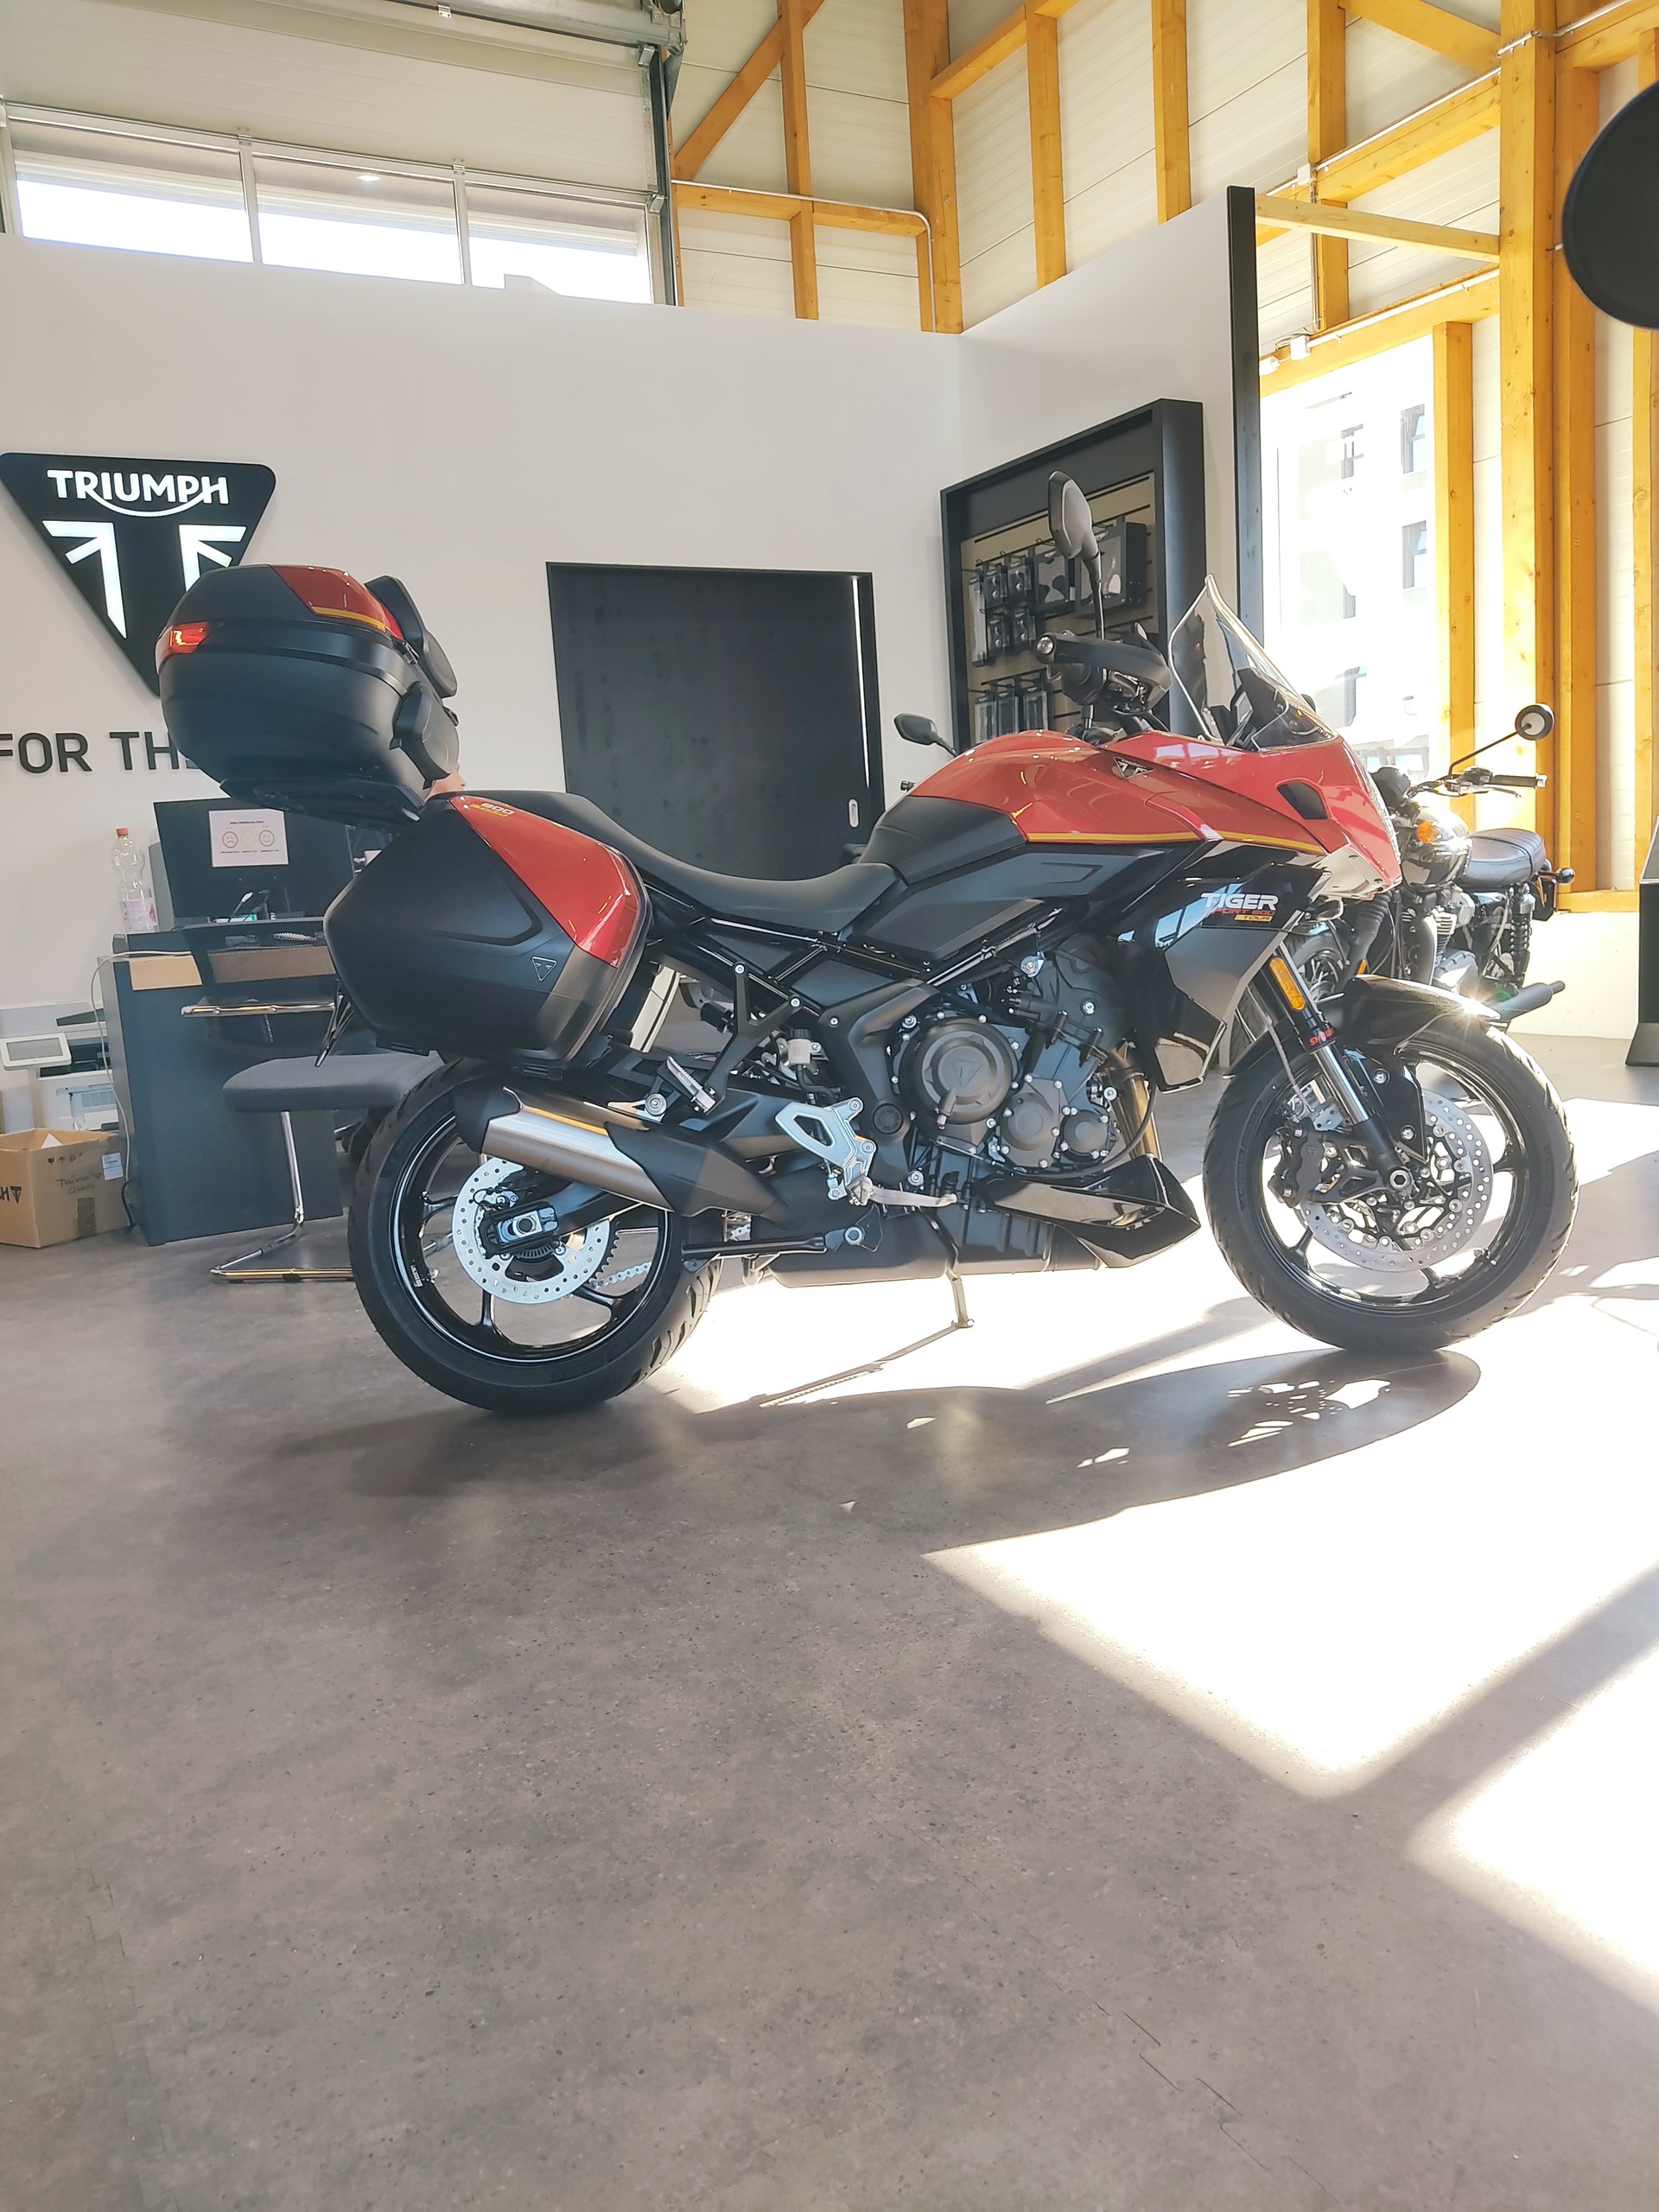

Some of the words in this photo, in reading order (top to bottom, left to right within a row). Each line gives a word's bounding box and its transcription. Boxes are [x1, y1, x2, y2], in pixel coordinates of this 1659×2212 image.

[47, 469, 230, 518] TRIUMPH
[0, 733, 92, 773] FOR
[109, 732, 200, 771] TH
[1201, 893, 1279, 911] TIGER
